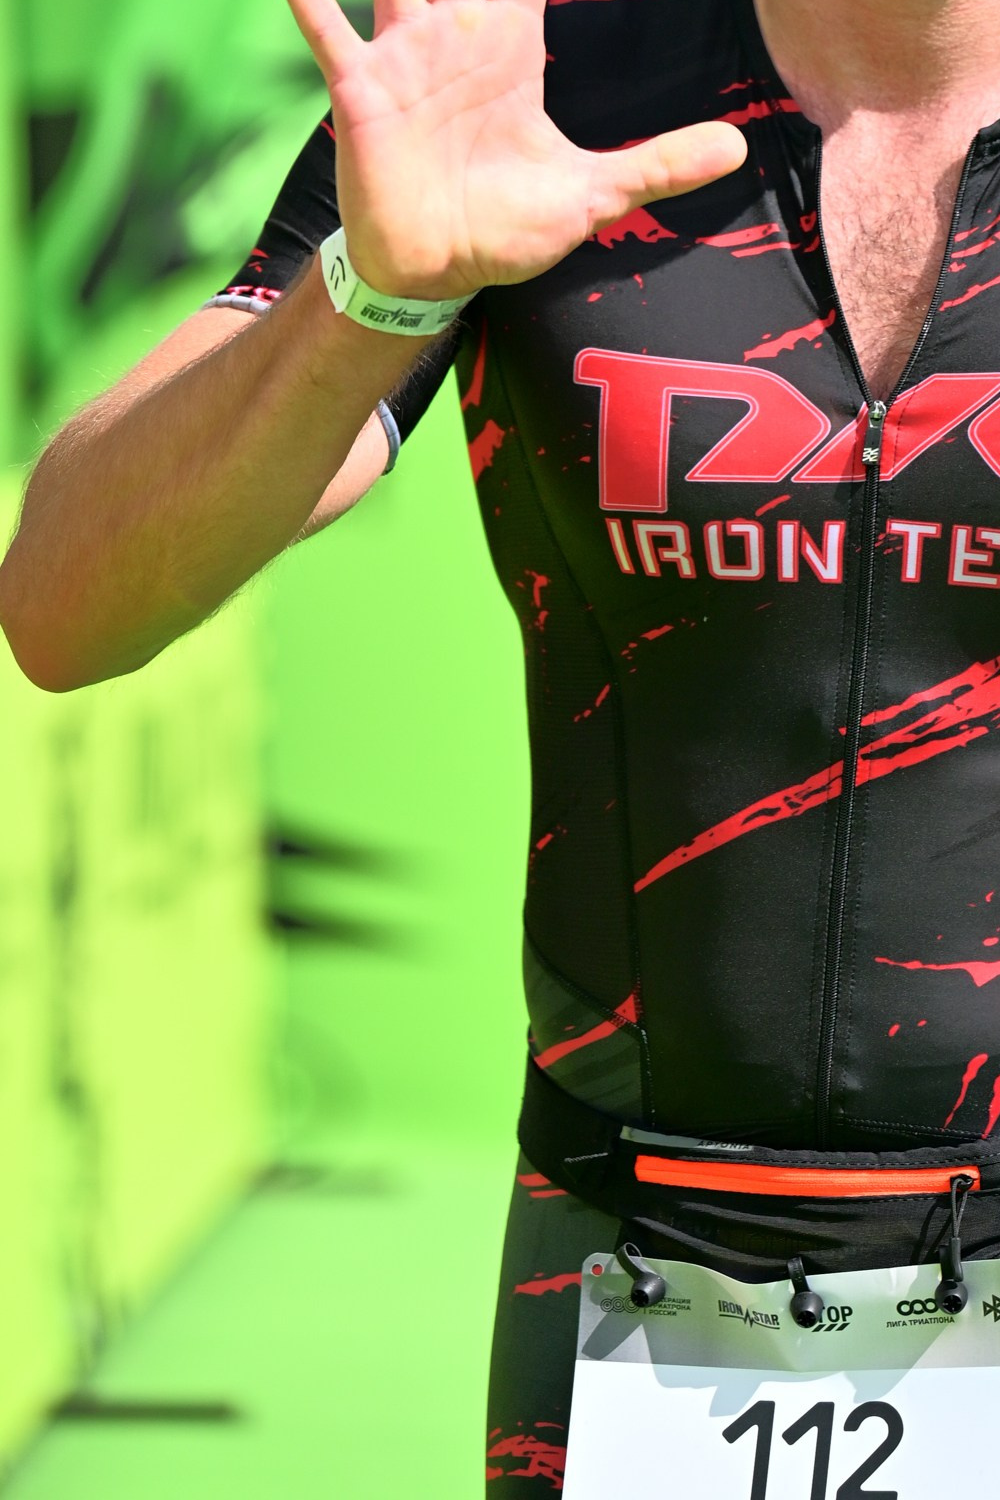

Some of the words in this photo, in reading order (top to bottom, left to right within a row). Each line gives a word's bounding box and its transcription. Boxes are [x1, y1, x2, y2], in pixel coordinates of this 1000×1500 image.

[605, 518, 846, 583] IRON
[718, 1299, 744, 1316] IRON
[752, 1310, 780, 1326] STAR
[886, 1319, 908, 1329] ЛИГА
[909, 1316, 956, 1326] ТРИАТЛОНА
[721, 1400, 905, 1500] 112
